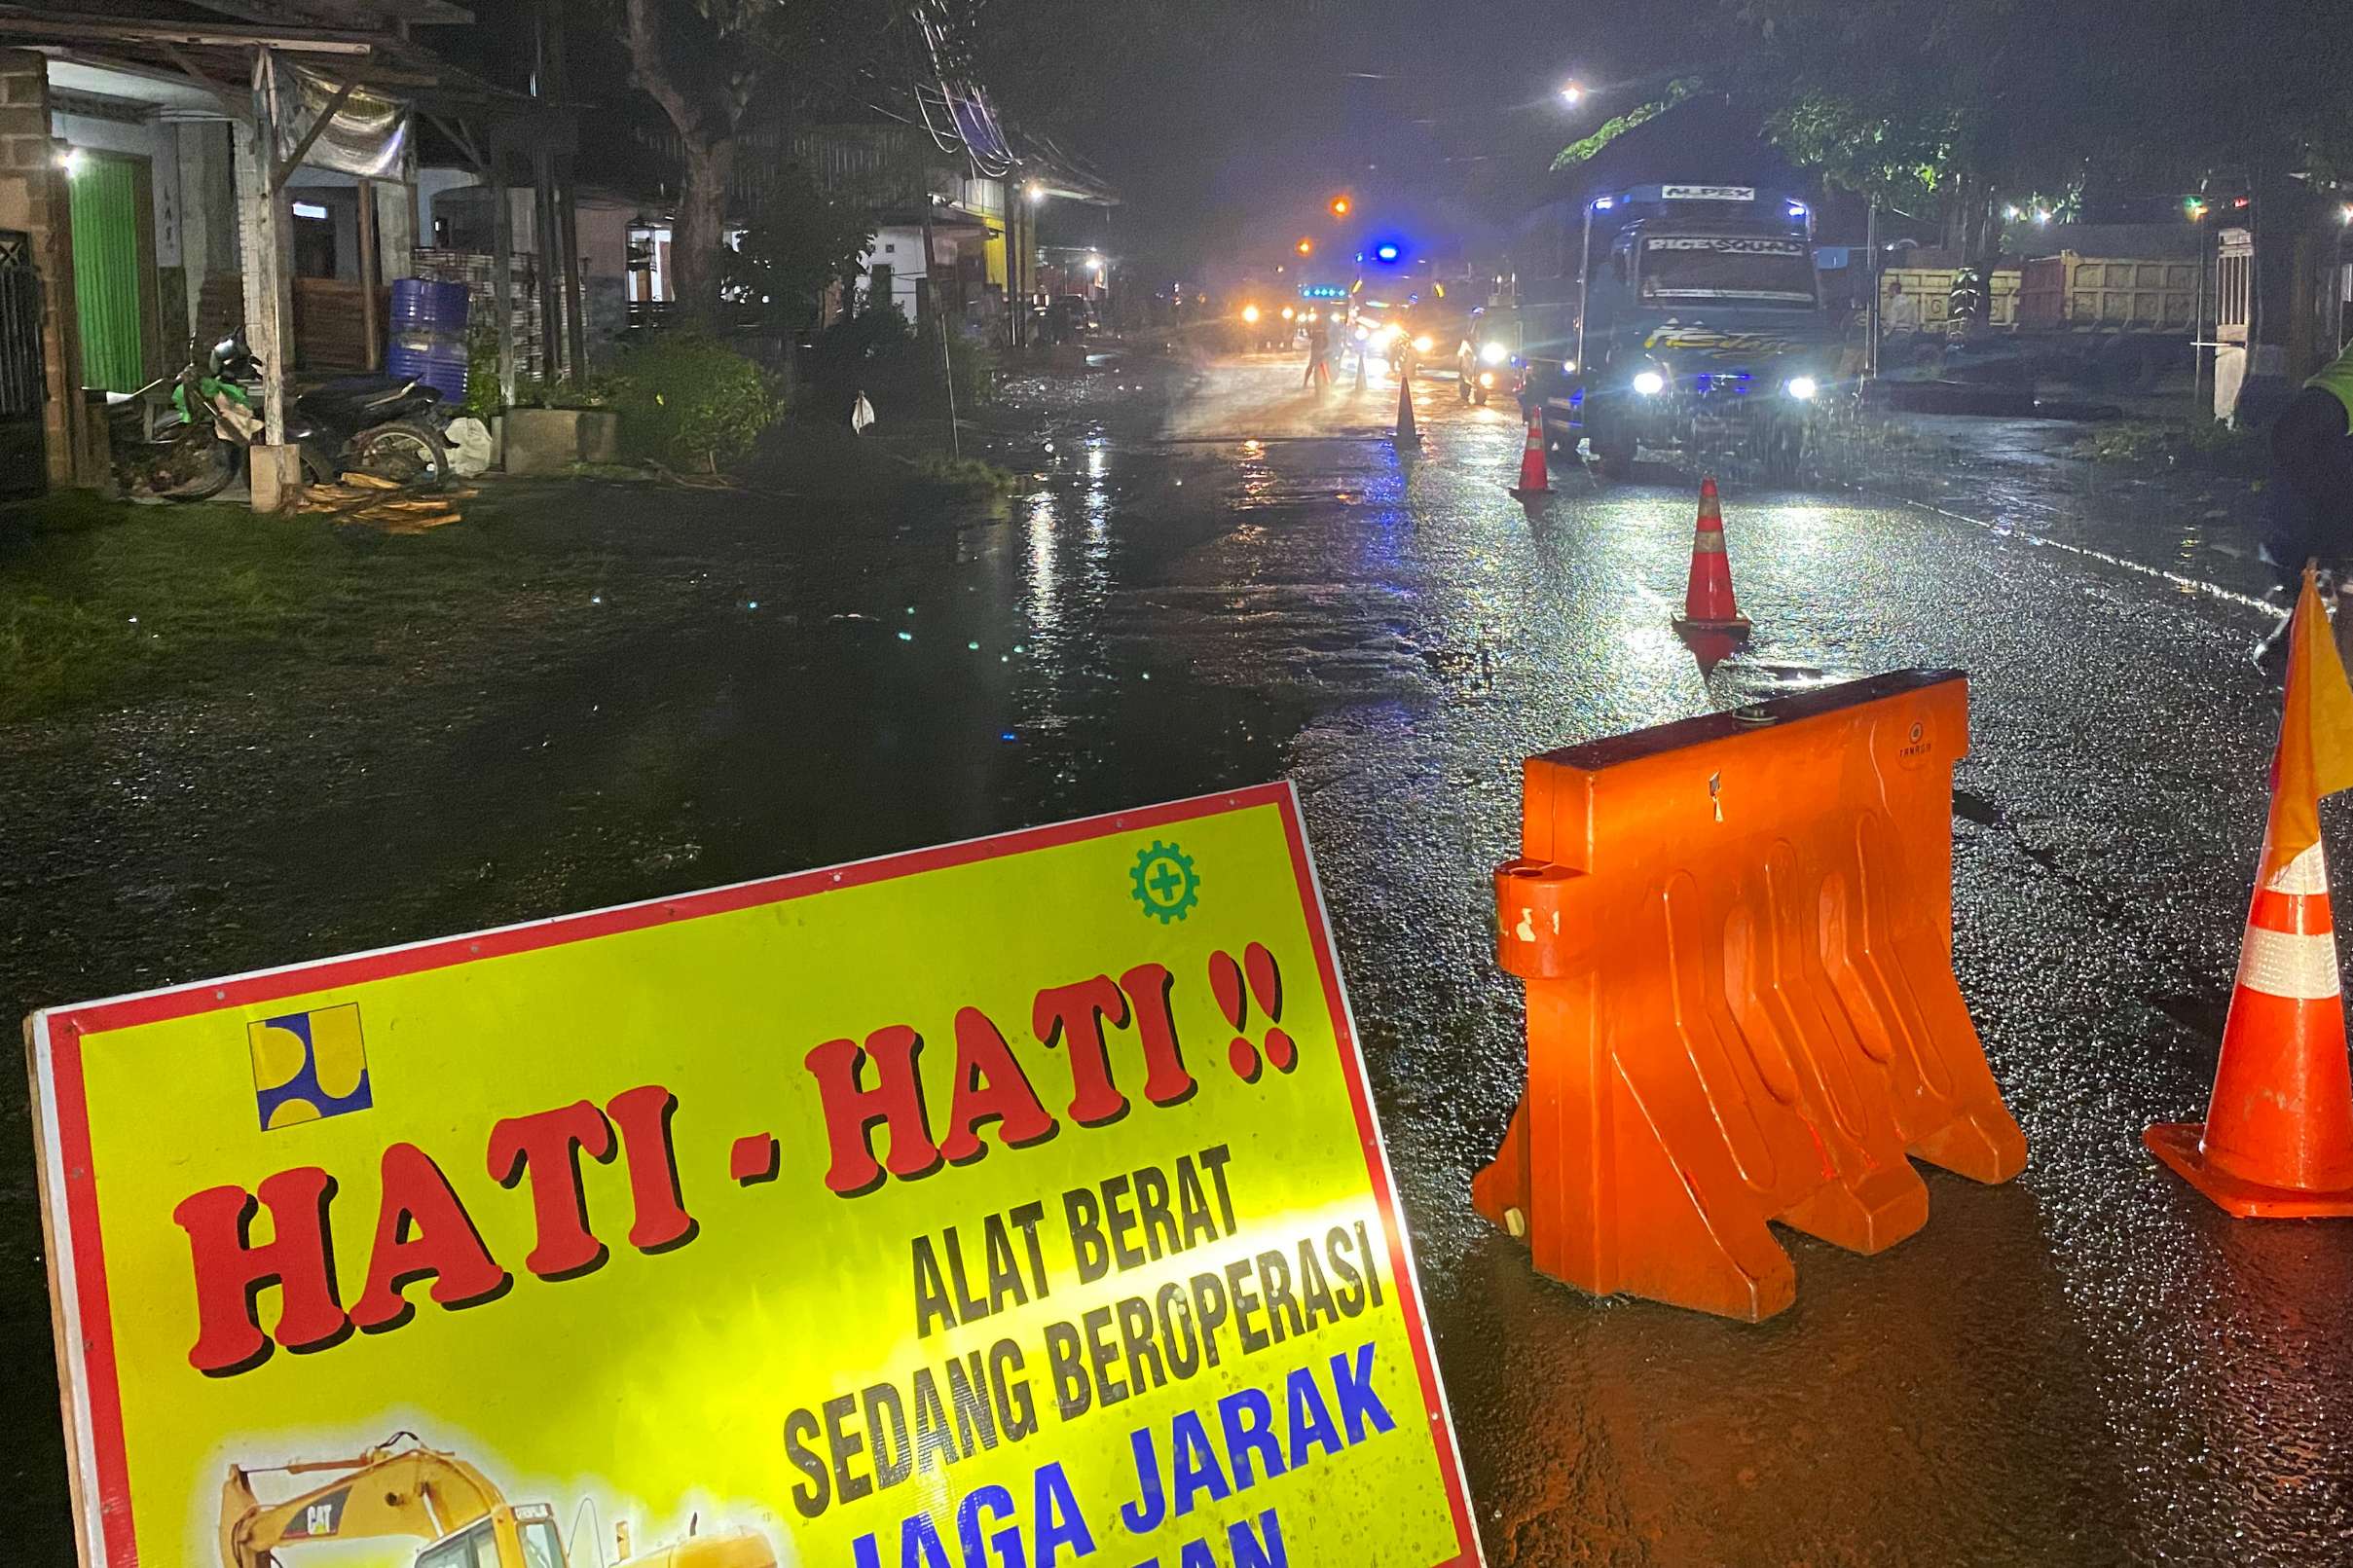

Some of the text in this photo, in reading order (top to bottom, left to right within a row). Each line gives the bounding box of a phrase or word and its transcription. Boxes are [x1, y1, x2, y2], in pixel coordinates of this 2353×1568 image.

[173, 1084, 701, 1379] HATI
[730, 1132, 781, 1185] -
[805, 963, 1198, 1200] HATI
[909, 1144, 1239, 1339] ALAT BERAT
[783, 1220, 1384, 1519] SEDANG BEROPERASI
[1121, 1342, 1396, 1535] JARAK
[307, 1504, 332, 1535] CAT
